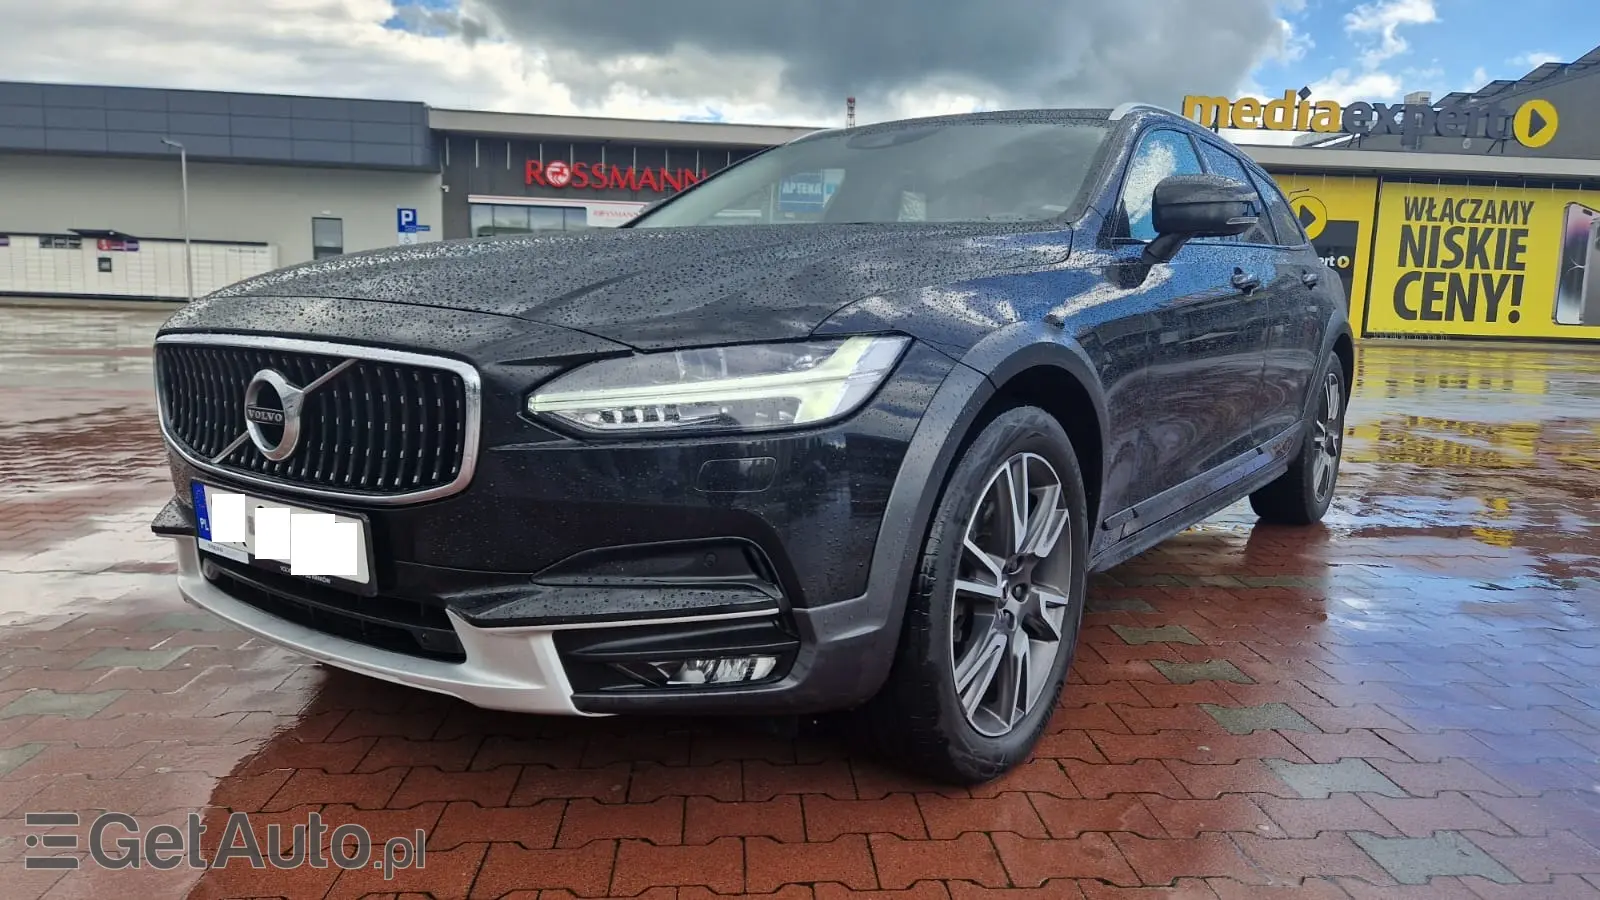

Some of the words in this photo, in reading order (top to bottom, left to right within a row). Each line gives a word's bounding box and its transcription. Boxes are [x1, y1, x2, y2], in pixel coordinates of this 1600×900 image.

[782, 182, 822, 194] APTEKA
[401, 210, 413, 226] P
[1404, 196, 1534, 225] WŁĄCZAMY
[1398, 224, 1528, 271] NISKIE
[1393, 271, 1524, 324] CENY!
[247, 409, 283, 422] VOLVO
